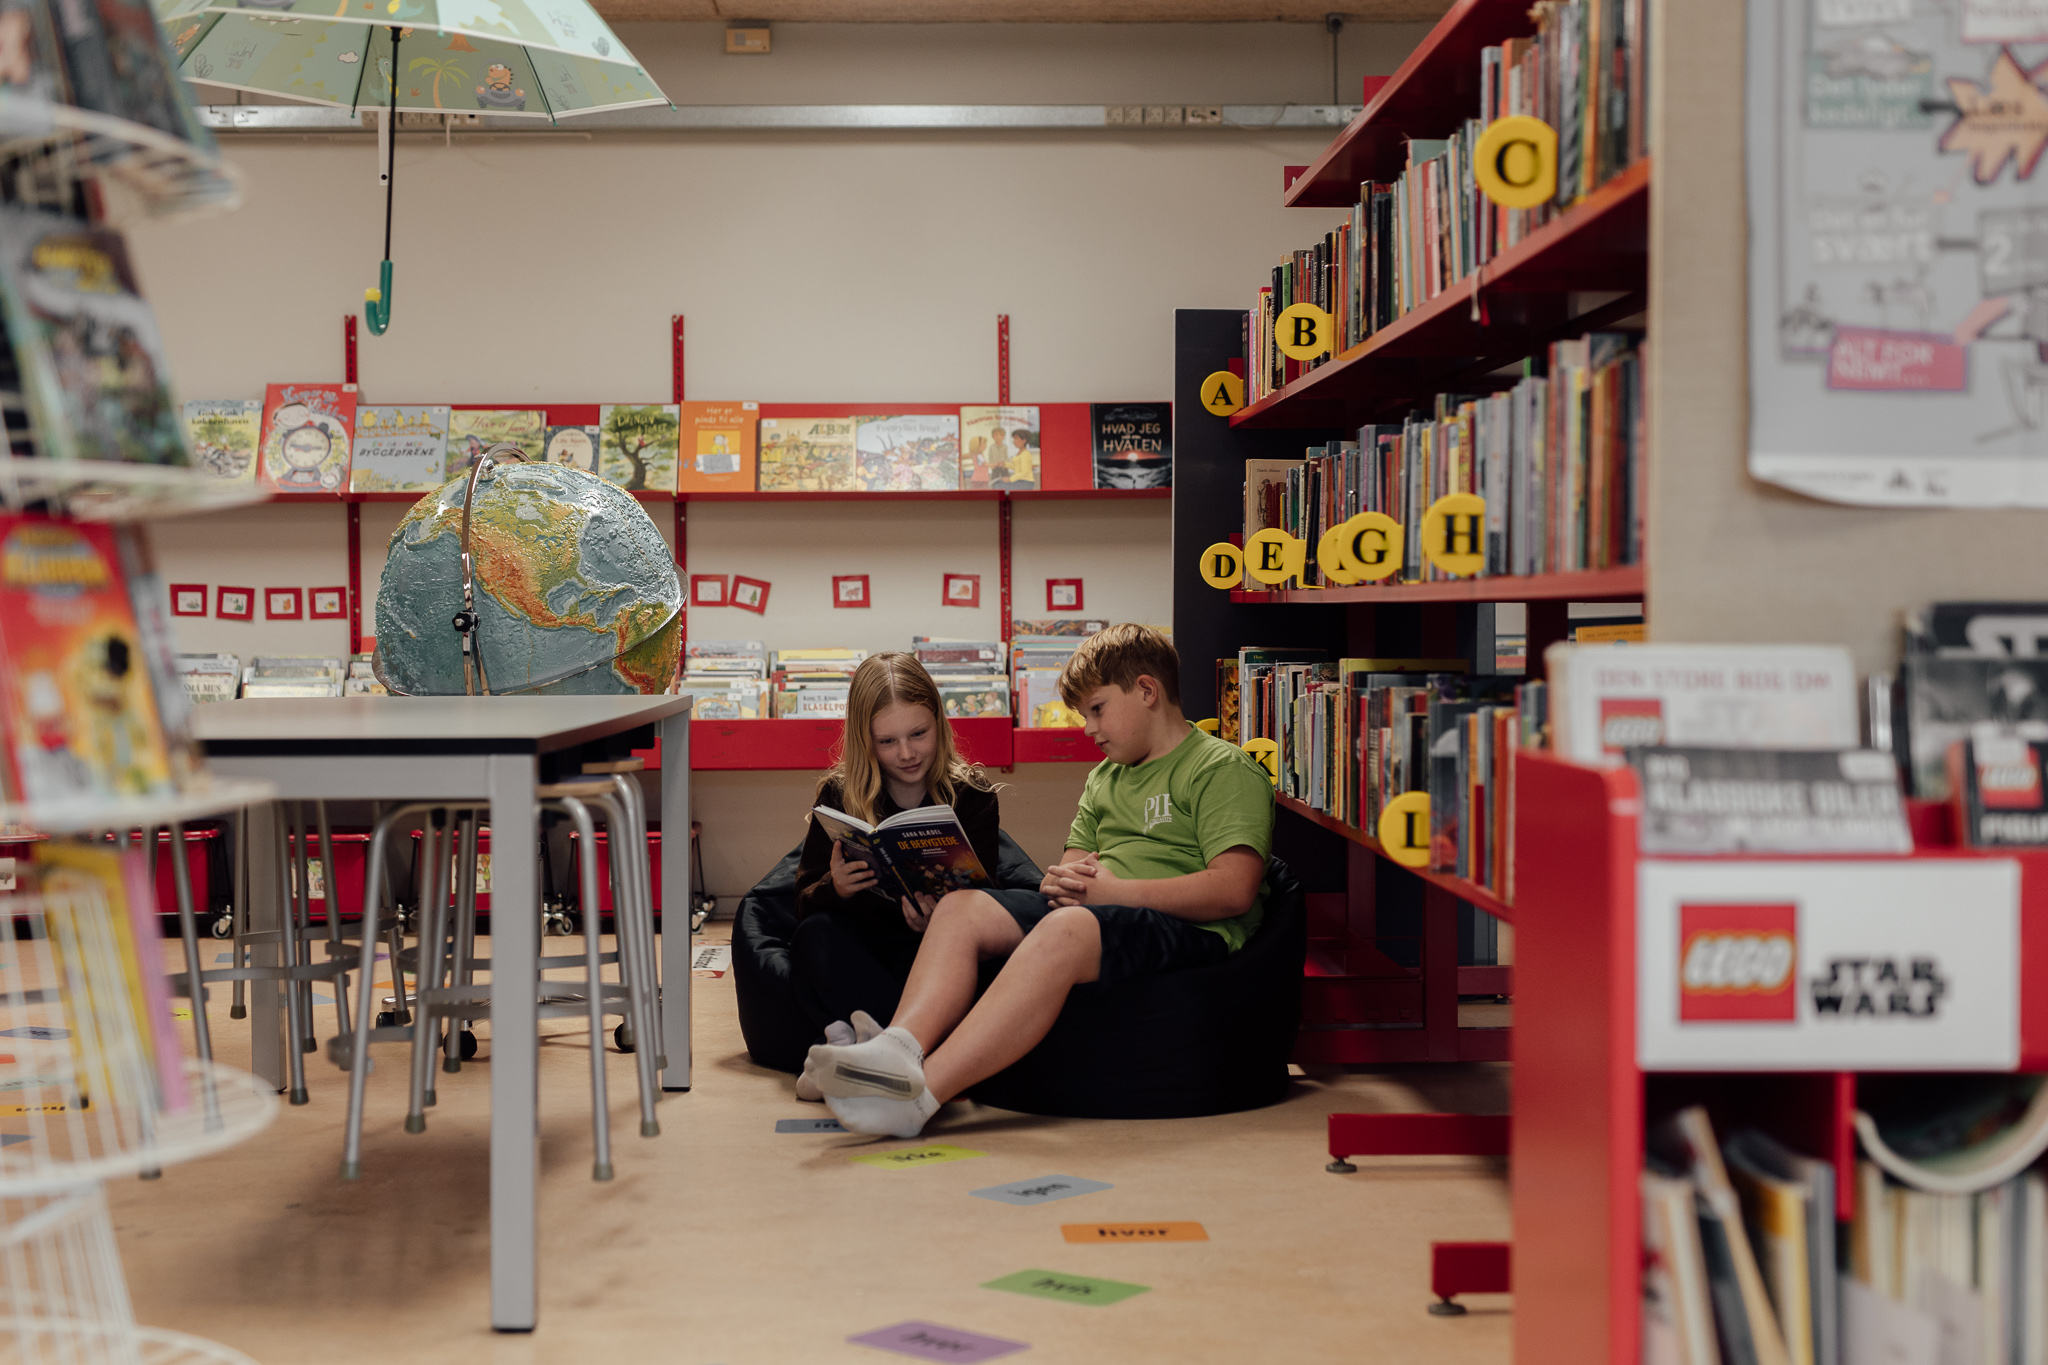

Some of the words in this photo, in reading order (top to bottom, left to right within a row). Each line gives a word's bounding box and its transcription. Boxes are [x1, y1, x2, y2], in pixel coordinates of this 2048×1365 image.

[1495, 139, 1538, 187] C
[1290, 316, 1318, 346] B
[1210, 382, 1234, 405] A
[808, 424, 850, 435] ALBIN
[1102, 423, 1136, 434] HVAD
[1139, 423, 1161, 434] JEG
[359, 448, 436, 457] BYGGEDYRENE
[1103, 439, 1162, 452] HVALEN
[1442, 513, 1482, 555] H
[1258, 541, 1284, 571] E
[1352, 528, 1390, 565] G
[1212, 554, 1236, 578] D
[1248, 751, 1276, 777] K
[897, 840, 911, 850] DE
[910, 836, 959, 849] BERYGTEDE
[1684, 934, 1794, 990] LEGO
[1098, 1227, 1168, 1237] hvor
